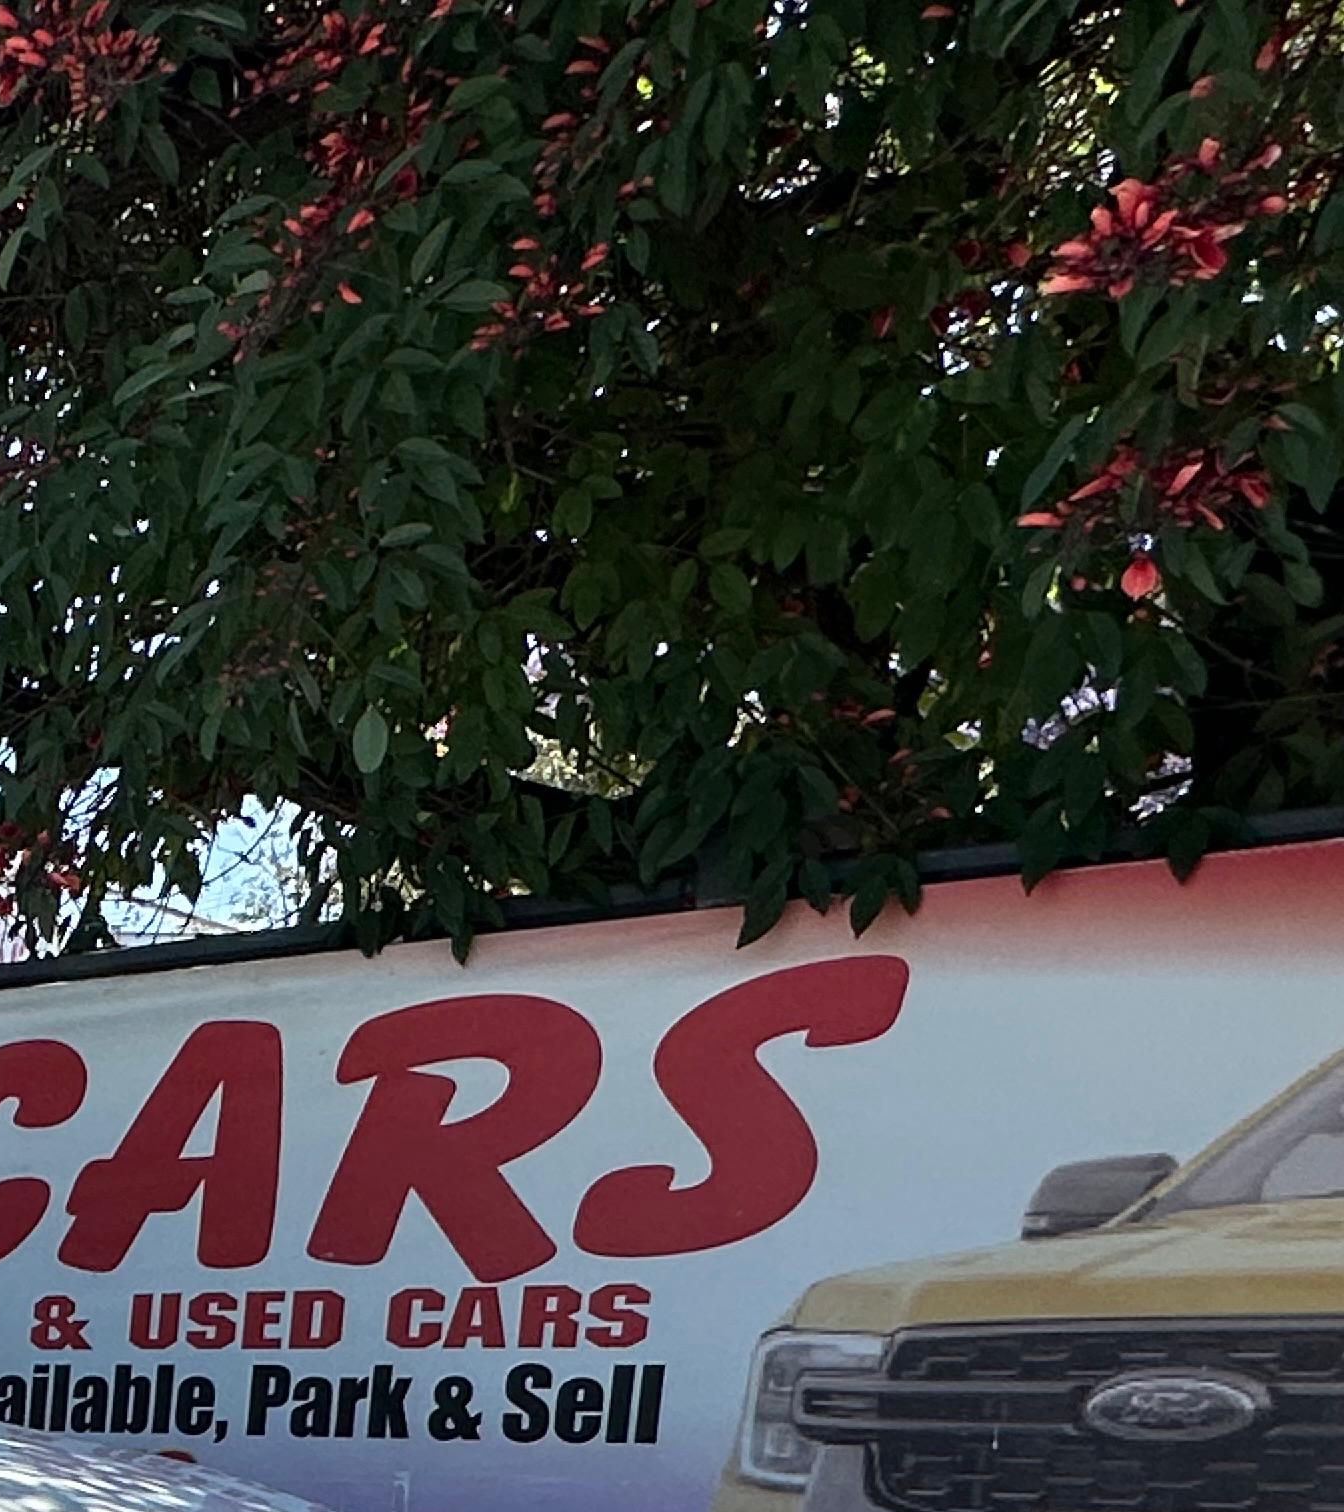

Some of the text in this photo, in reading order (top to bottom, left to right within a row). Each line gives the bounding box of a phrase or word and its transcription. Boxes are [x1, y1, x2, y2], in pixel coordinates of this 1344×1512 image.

[29, 1293, 93, 1351] &
[128, 1289, 346, 1350] USED
[385, 1283, 653, 1350] CARS
[245, 1363, 413, 1440] Park
[427, 1375, 483, 1443] &
[502, 1362, 666, 1445] Sell
